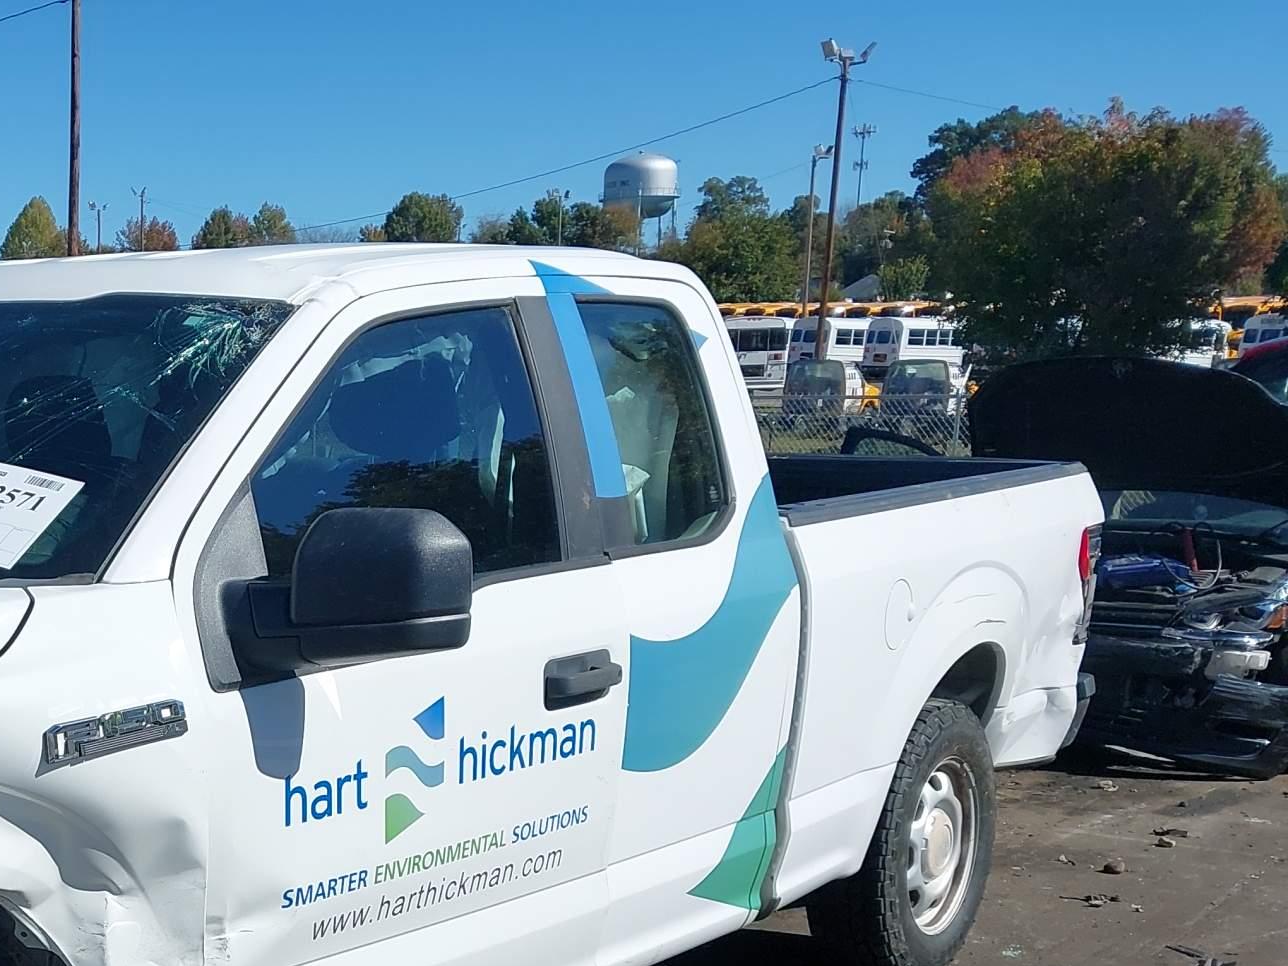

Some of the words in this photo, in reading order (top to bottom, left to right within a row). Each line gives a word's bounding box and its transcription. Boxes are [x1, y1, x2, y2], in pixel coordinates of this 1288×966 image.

[284, 758, 368, 827] hart
[458, 718, 596, 784] hickman
[281, 869, 368, 909] SMARTER
[373, 830, 506, 885] ENVIRONMENTAL
[512, 805, 589, 844] SOLUTIONS
[312, 848, 563, 941] www.harthickman.com
